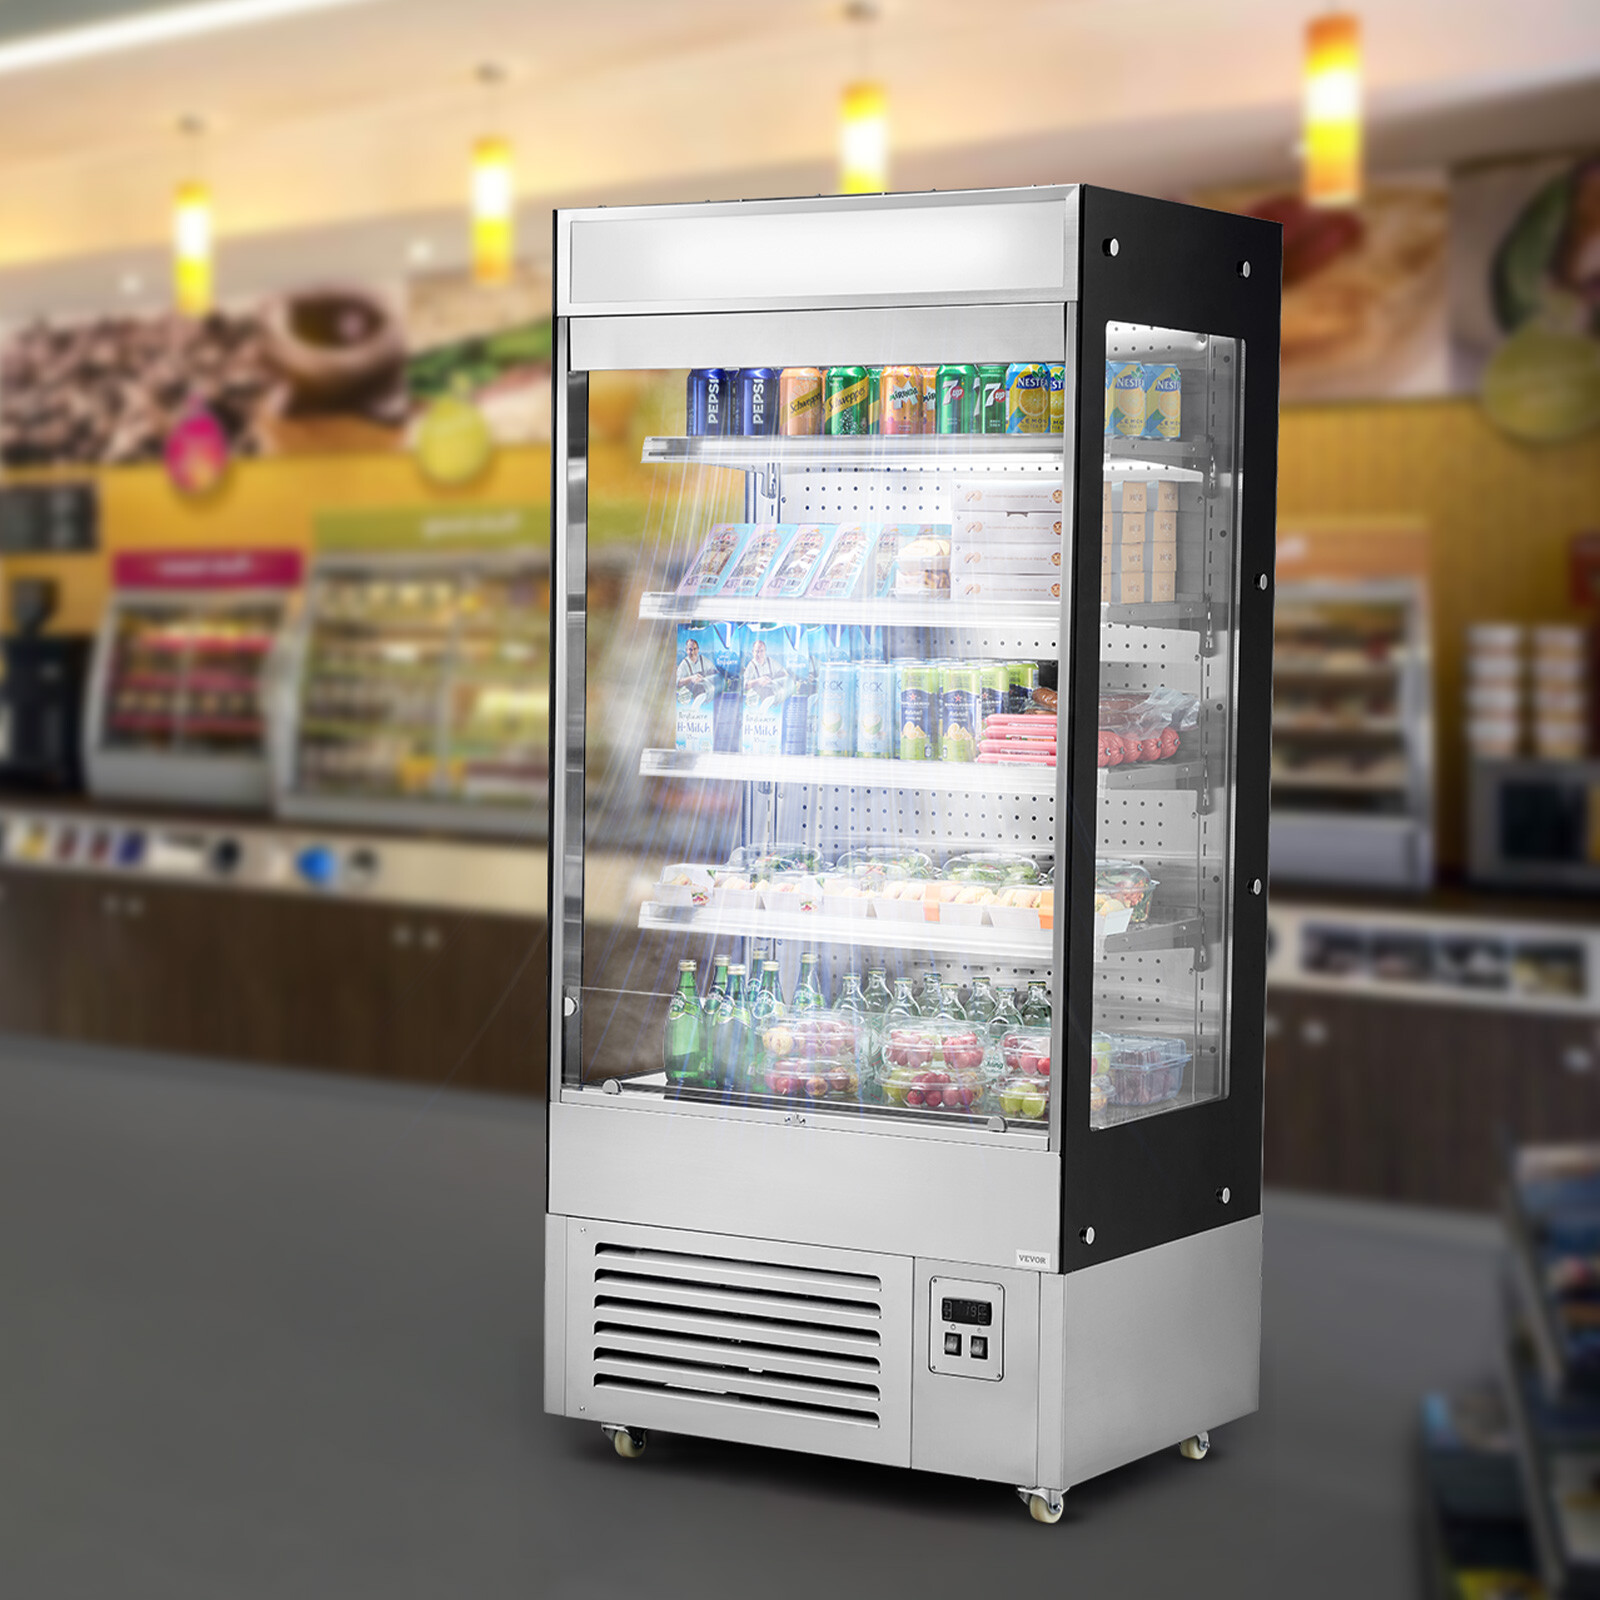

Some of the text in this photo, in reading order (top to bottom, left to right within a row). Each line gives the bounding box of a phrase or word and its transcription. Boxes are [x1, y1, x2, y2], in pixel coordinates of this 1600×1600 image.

[708, 379, 719, 424] PEPSI
[752, 379, 764, 424] PEPSI
[1018, 1254, 1047, 1264] VEVOR
